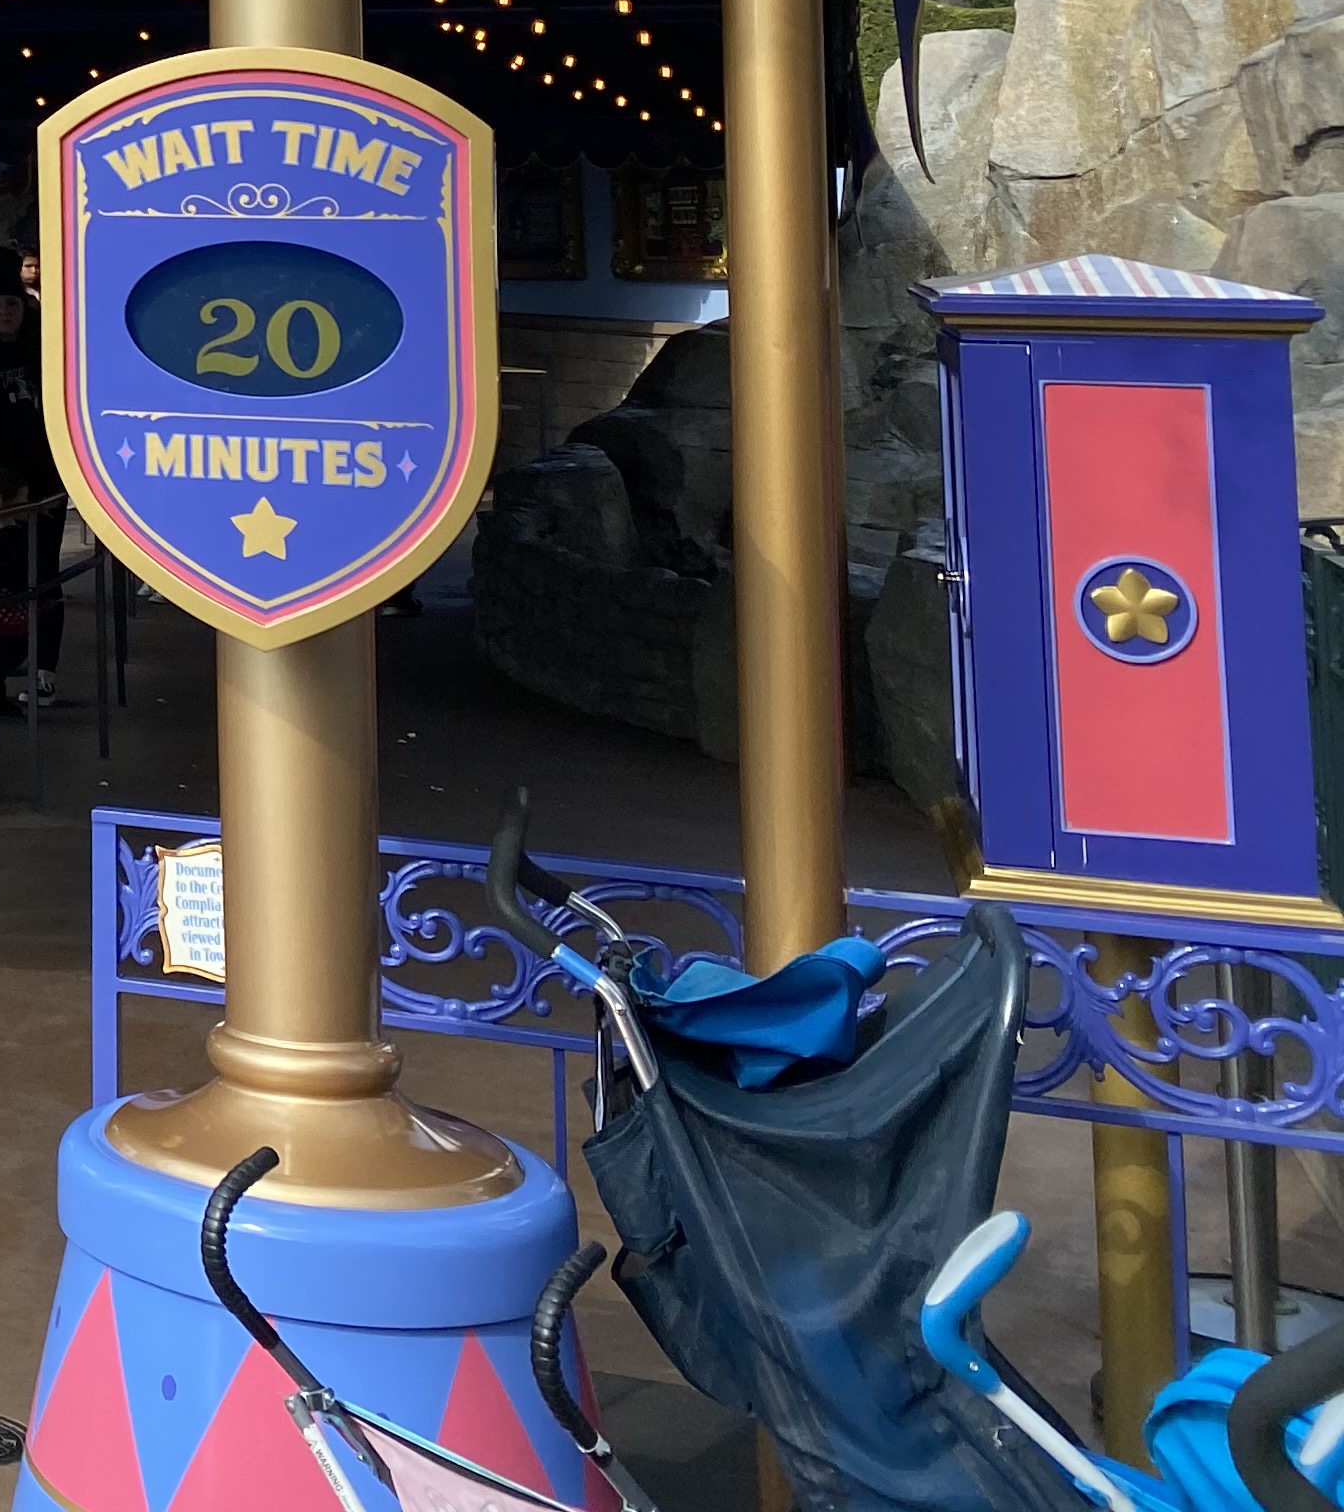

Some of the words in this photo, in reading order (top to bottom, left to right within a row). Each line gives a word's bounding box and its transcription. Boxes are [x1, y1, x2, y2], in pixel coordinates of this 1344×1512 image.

[103, 119, 255, 191] WAIT
[271, 120, 423, 196] TIME
[196, 298, 342, 379] 20
[144, 432, 387, 488] MINUTES
[175, 880, 187, 893] to
[189, 880, 208, 894] the
[181, 930, 221, 946] viewed
[190, 947, 201, 961] in
[315, 1448, 344, 1492] WARNING
